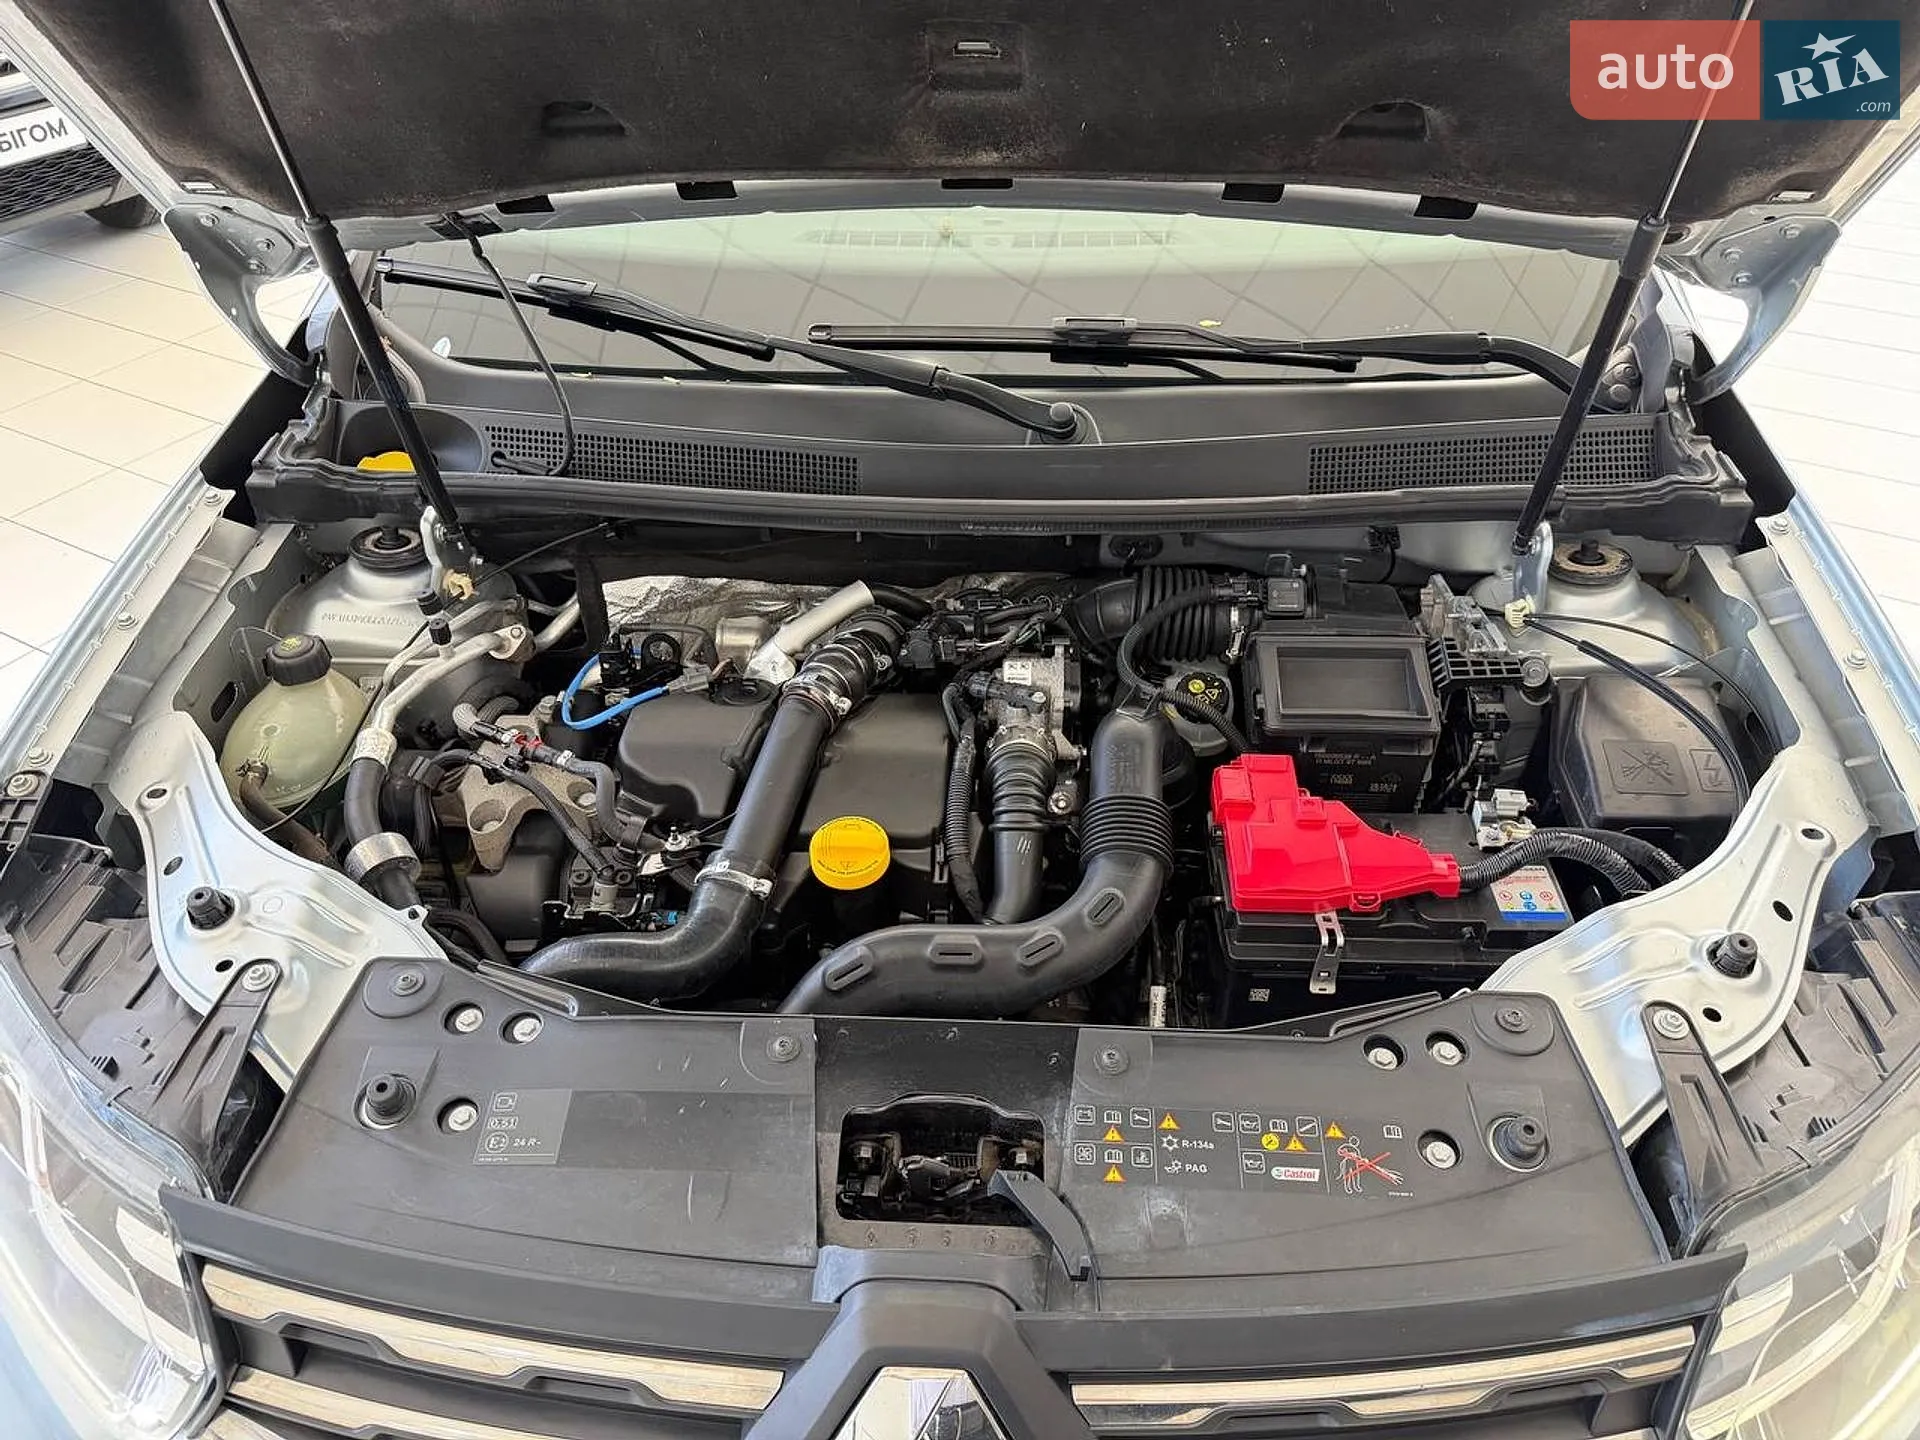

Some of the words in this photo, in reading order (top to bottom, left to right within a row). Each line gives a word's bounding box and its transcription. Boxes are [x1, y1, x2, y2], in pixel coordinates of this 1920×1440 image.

[1181, 1139, 1215, 1150] R-134a
[1184, 1163, 1208, 1173] PAG
[1283, 1168, 1316, 1179] Castrol
